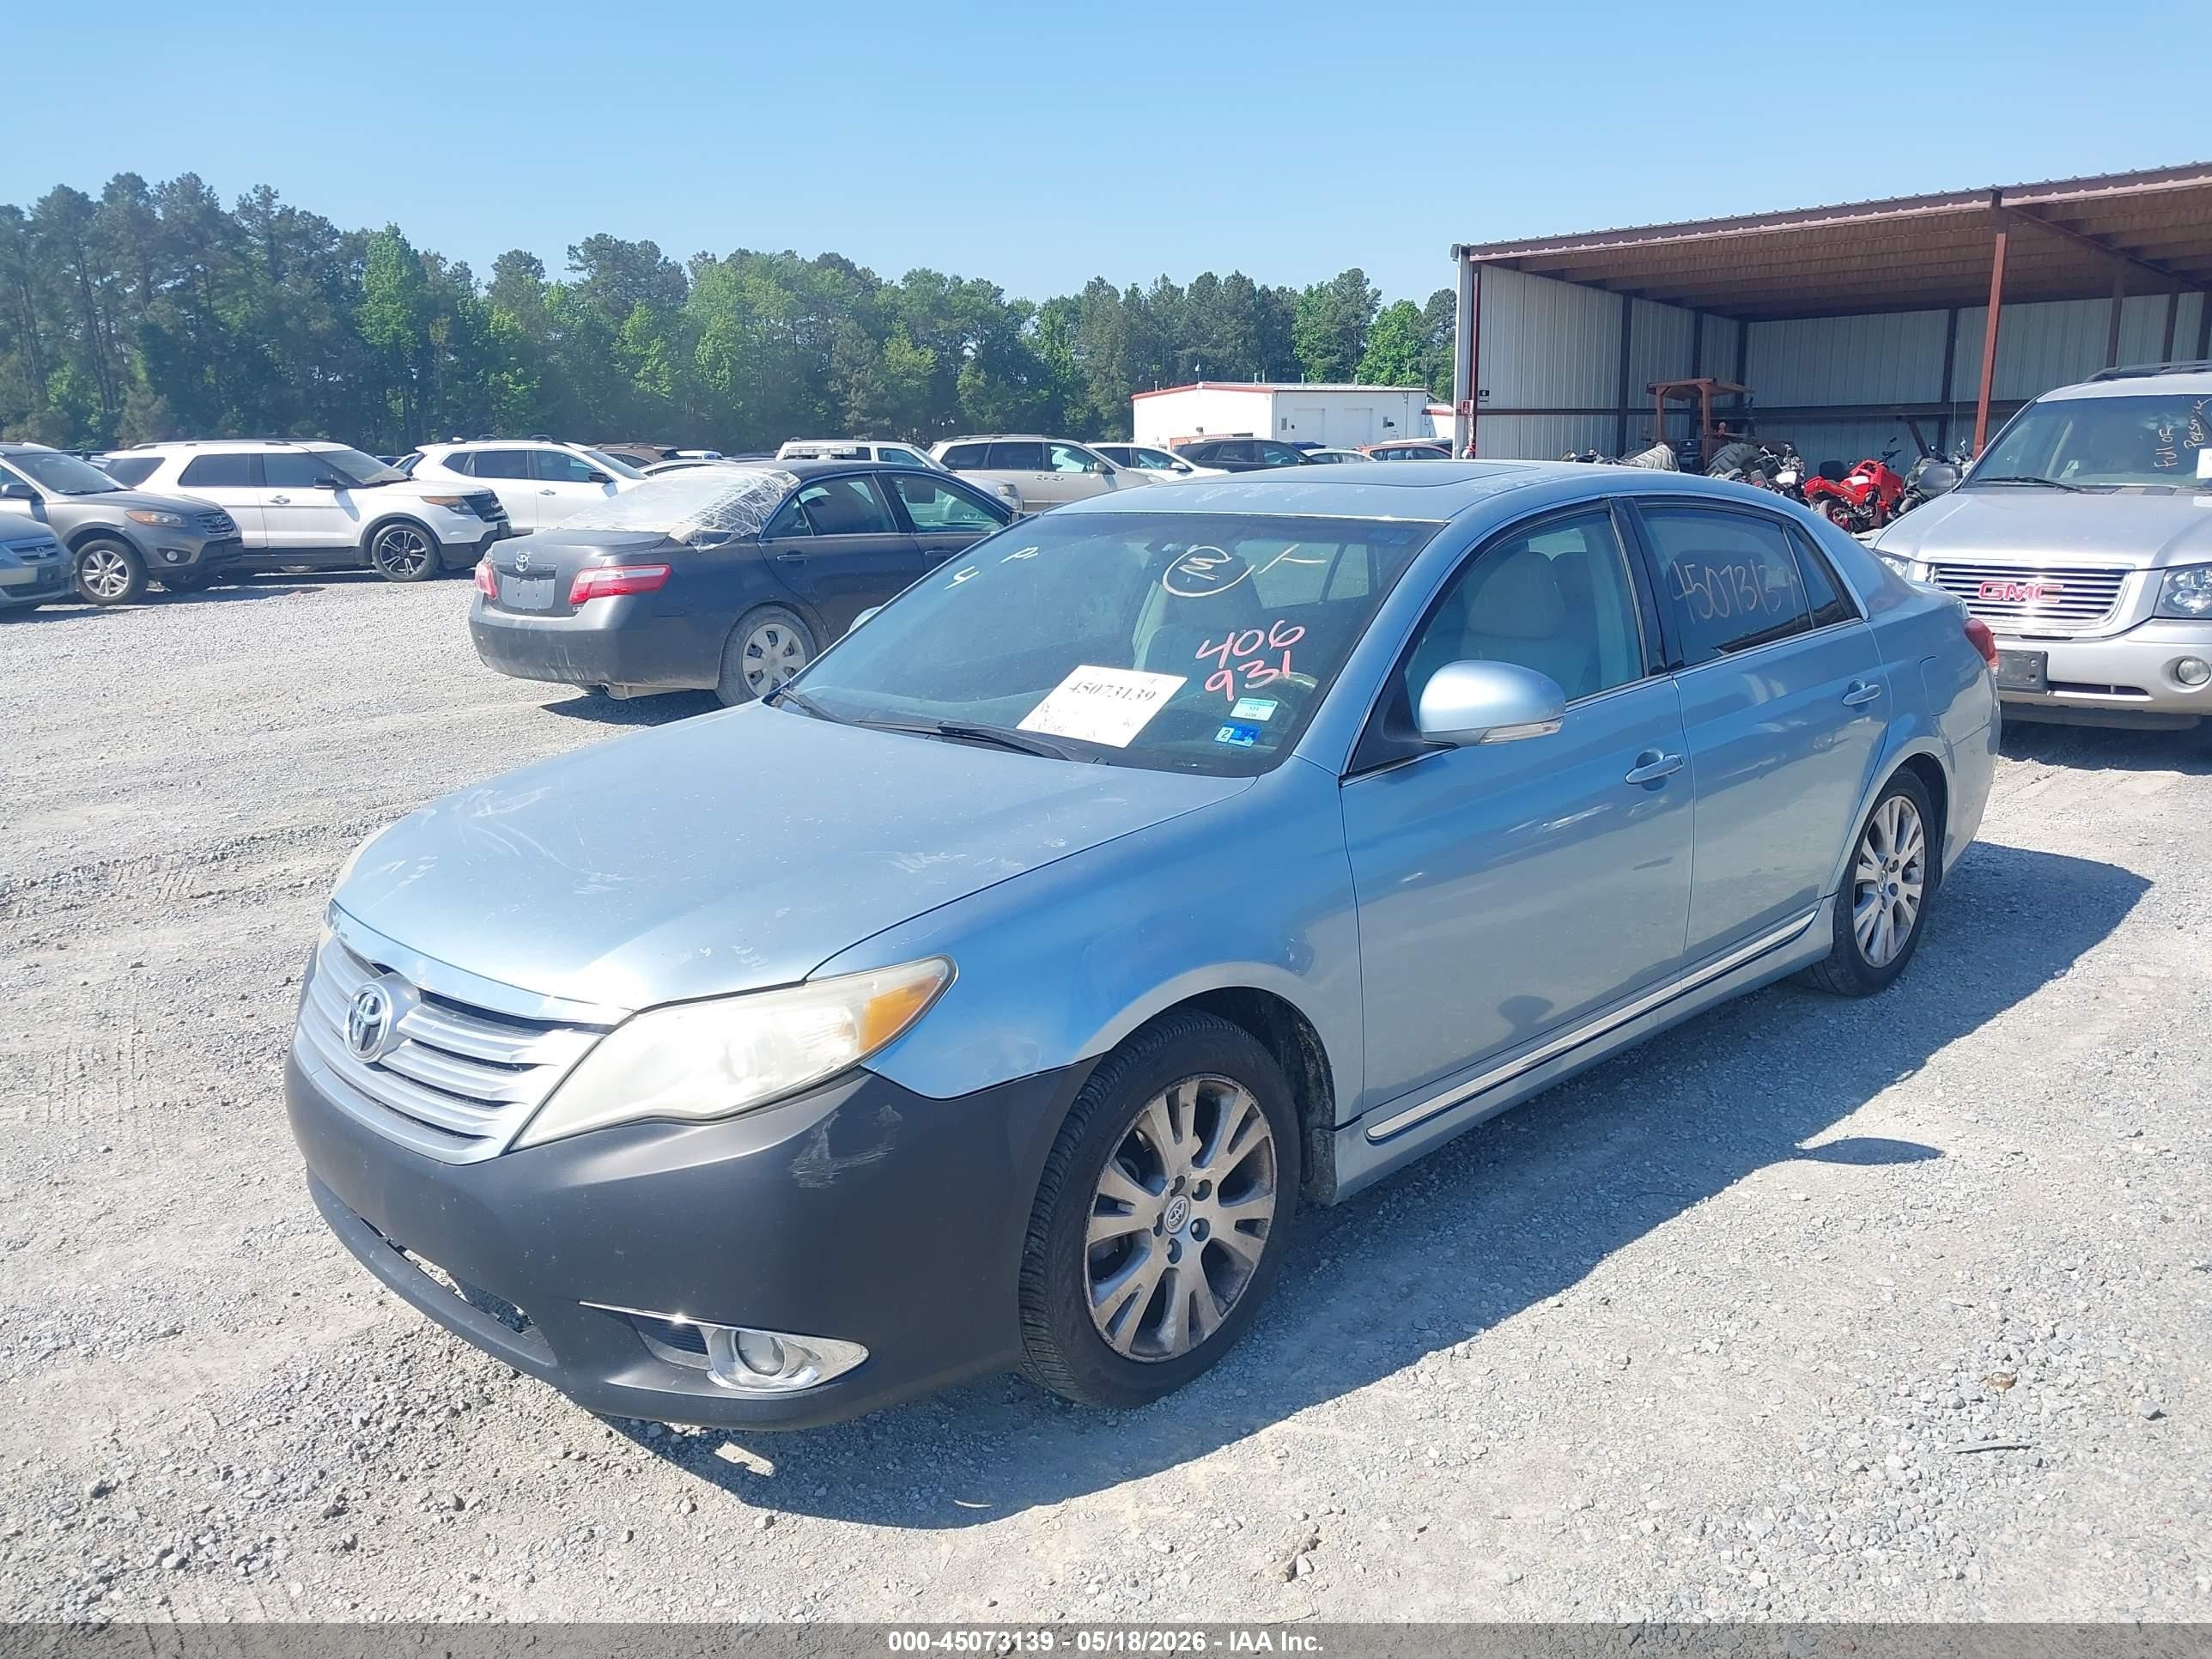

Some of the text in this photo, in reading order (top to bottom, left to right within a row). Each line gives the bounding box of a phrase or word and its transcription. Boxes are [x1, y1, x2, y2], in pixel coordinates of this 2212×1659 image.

[1978, 581, 2063, 603] GMC
[1195, 619, 1306, 669] 406
[1204, 650, 1291, 702] 931
[1069, 681, 1158, 702] 45073139
[1221, 729, 1231, 738] 2
